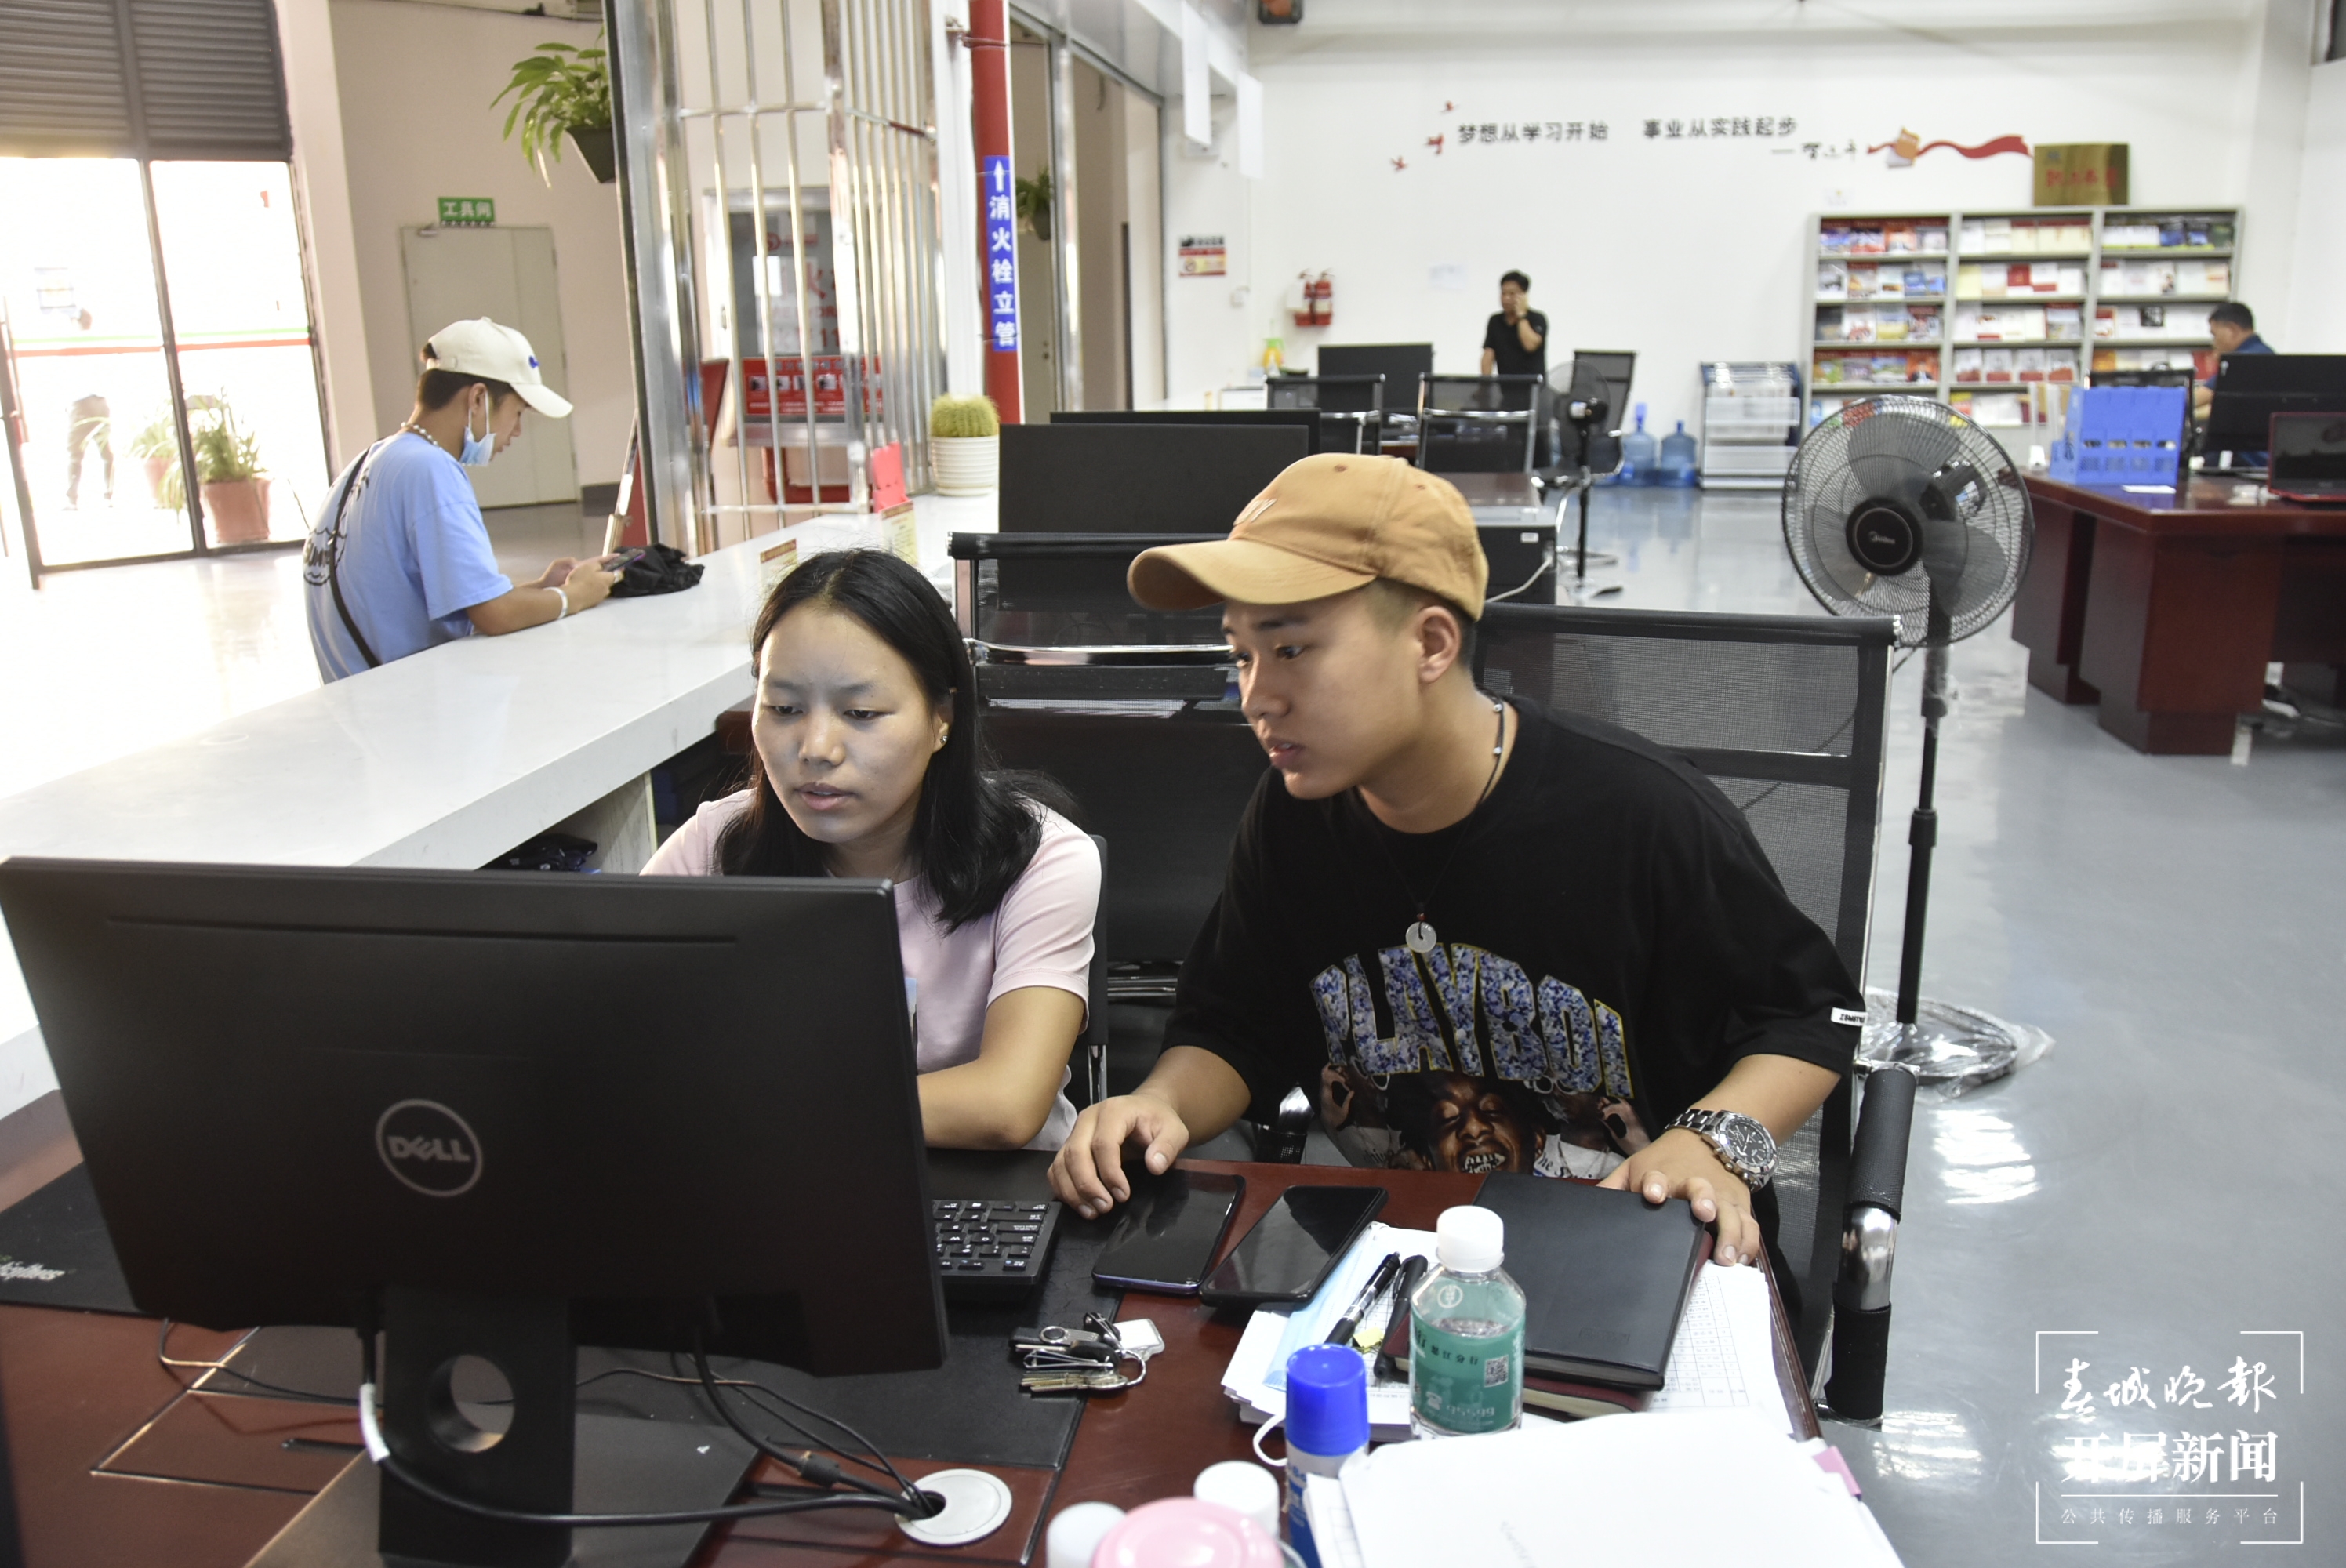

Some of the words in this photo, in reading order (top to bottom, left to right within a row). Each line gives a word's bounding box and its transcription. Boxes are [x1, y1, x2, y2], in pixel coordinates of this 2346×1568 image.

[1458, 121, 1608, 144] 梦想从学习开始
[1644, 118, 1797, 139] 事业从实践起步
[443, 201, 492, 217] 工具间
[989, 195, 1017, 348] 消火栓立管
[1310, 943, 1635, 1098] PLAYBOI
[388, 1136, 470, 1162] DELL
